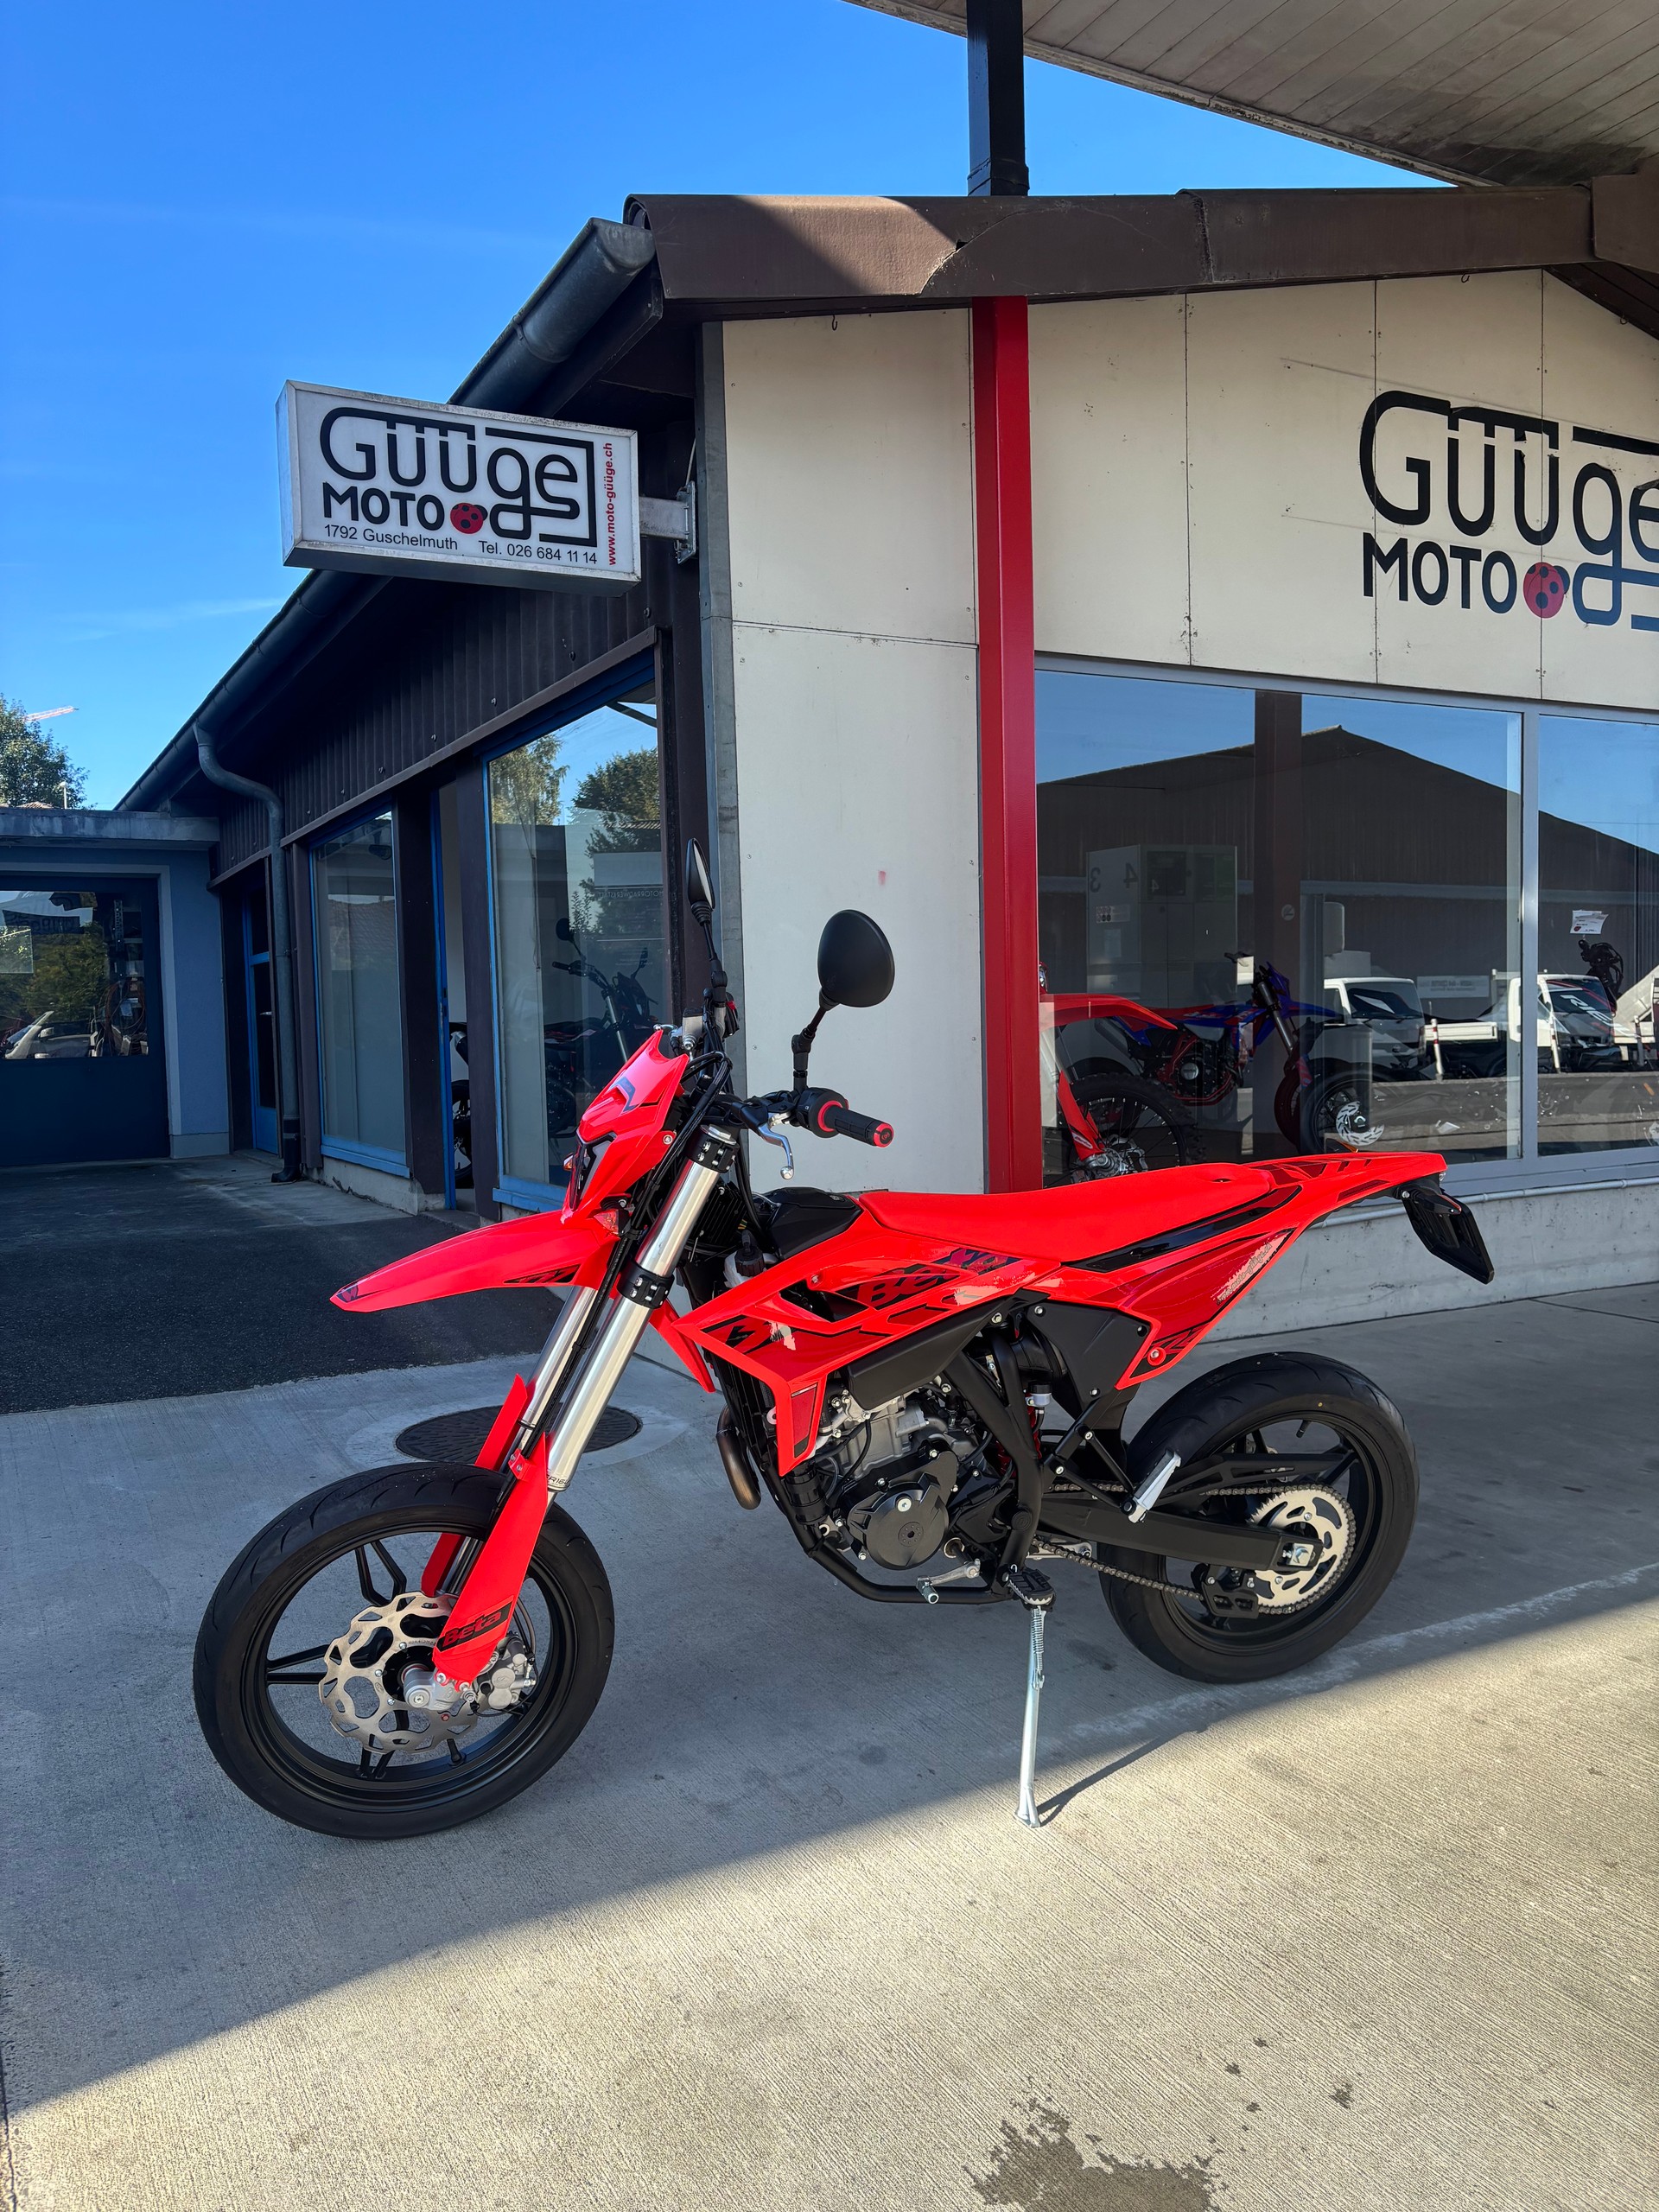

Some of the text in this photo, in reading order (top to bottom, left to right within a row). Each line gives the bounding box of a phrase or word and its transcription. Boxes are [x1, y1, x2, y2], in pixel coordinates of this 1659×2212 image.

[323, 481, 445, 531] MOTO
[603, 442, 616, 566] www.moto-güüge.ch
[324, 524, 597, 564] 1792 Guschelmuth Tel. 026 684 11 14
[1363, 532, 1517, 613] MOTO
[442, 1611, 501, 1648] Beta
